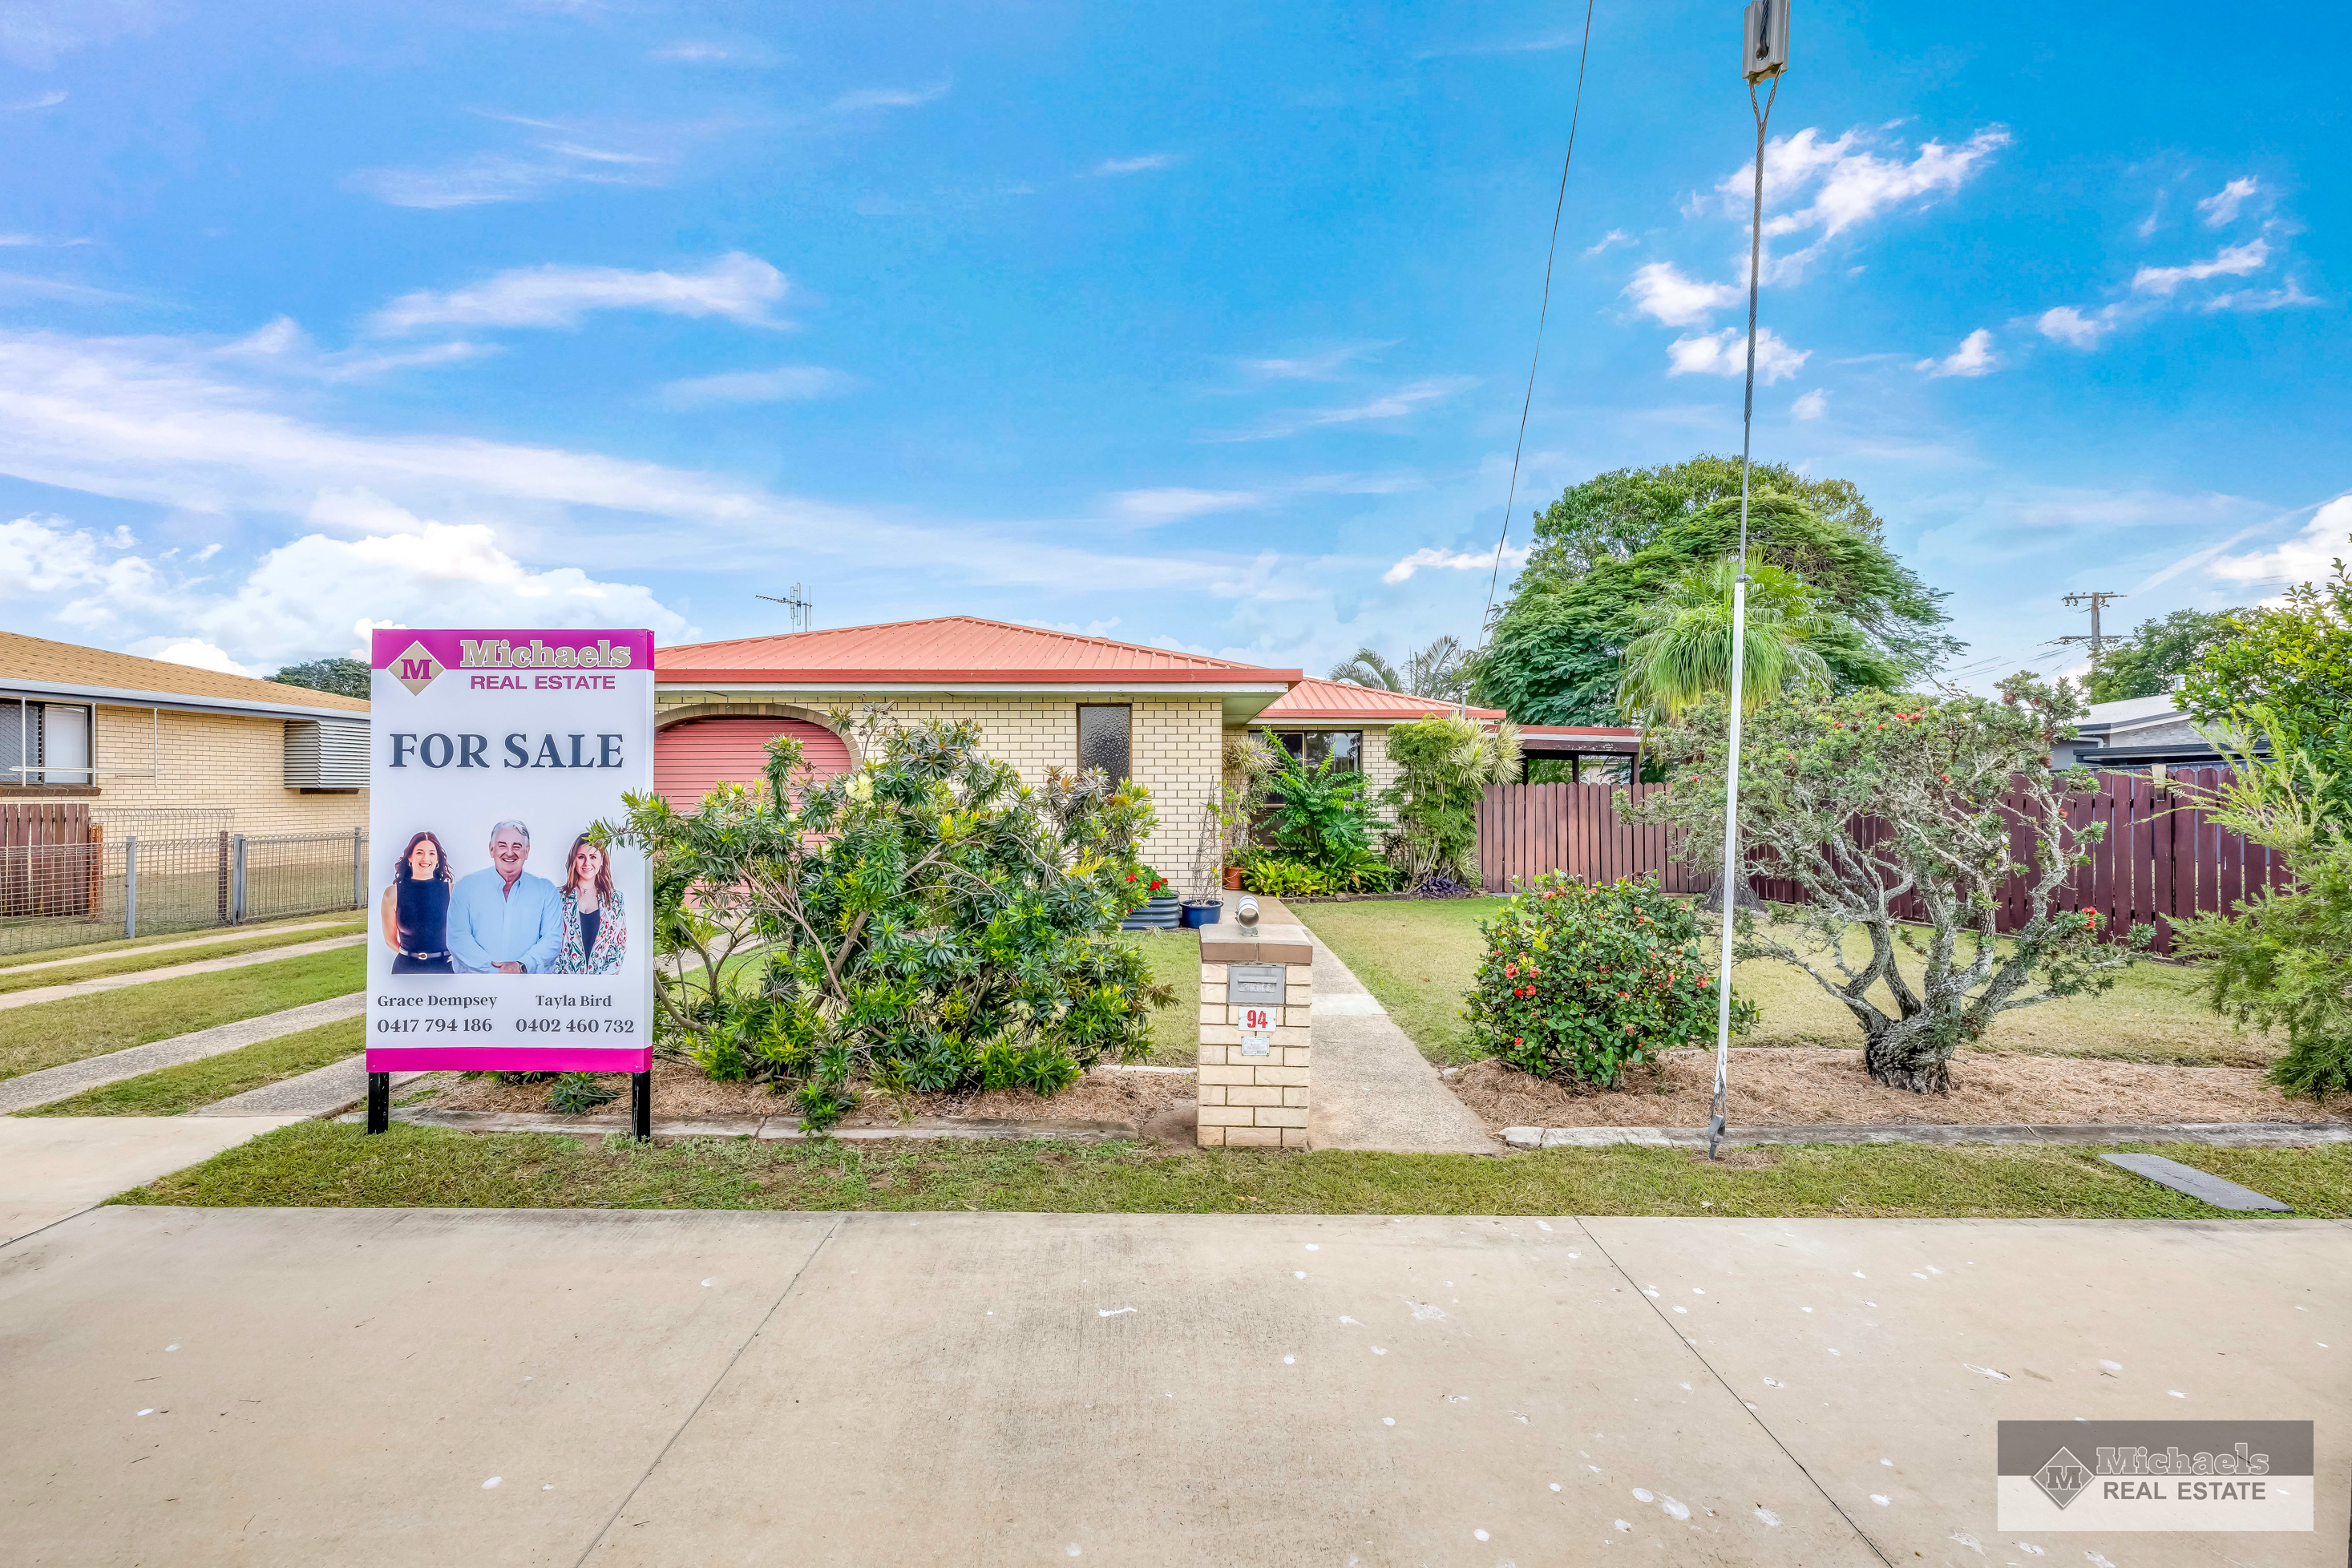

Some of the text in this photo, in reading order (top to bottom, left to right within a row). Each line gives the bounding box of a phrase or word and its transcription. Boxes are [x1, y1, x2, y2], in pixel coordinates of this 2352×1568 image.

[459, 639, 632, 668] Michaels
[401, 659, 432, 680] M
[471, 676, 616, 689] REAL ESTATE
[389, 733, 624, 768] FOR SALE
[377, 995, 498, 1008] Grace Dempsey
[535, 994, 612, 1009] Tayla Bird
[377, 1018, 492, 1033] 0417 794 186
[515, 1018, 635, 1033] 0402 460 732
[1247, 1010, 1267, 1028] 94
